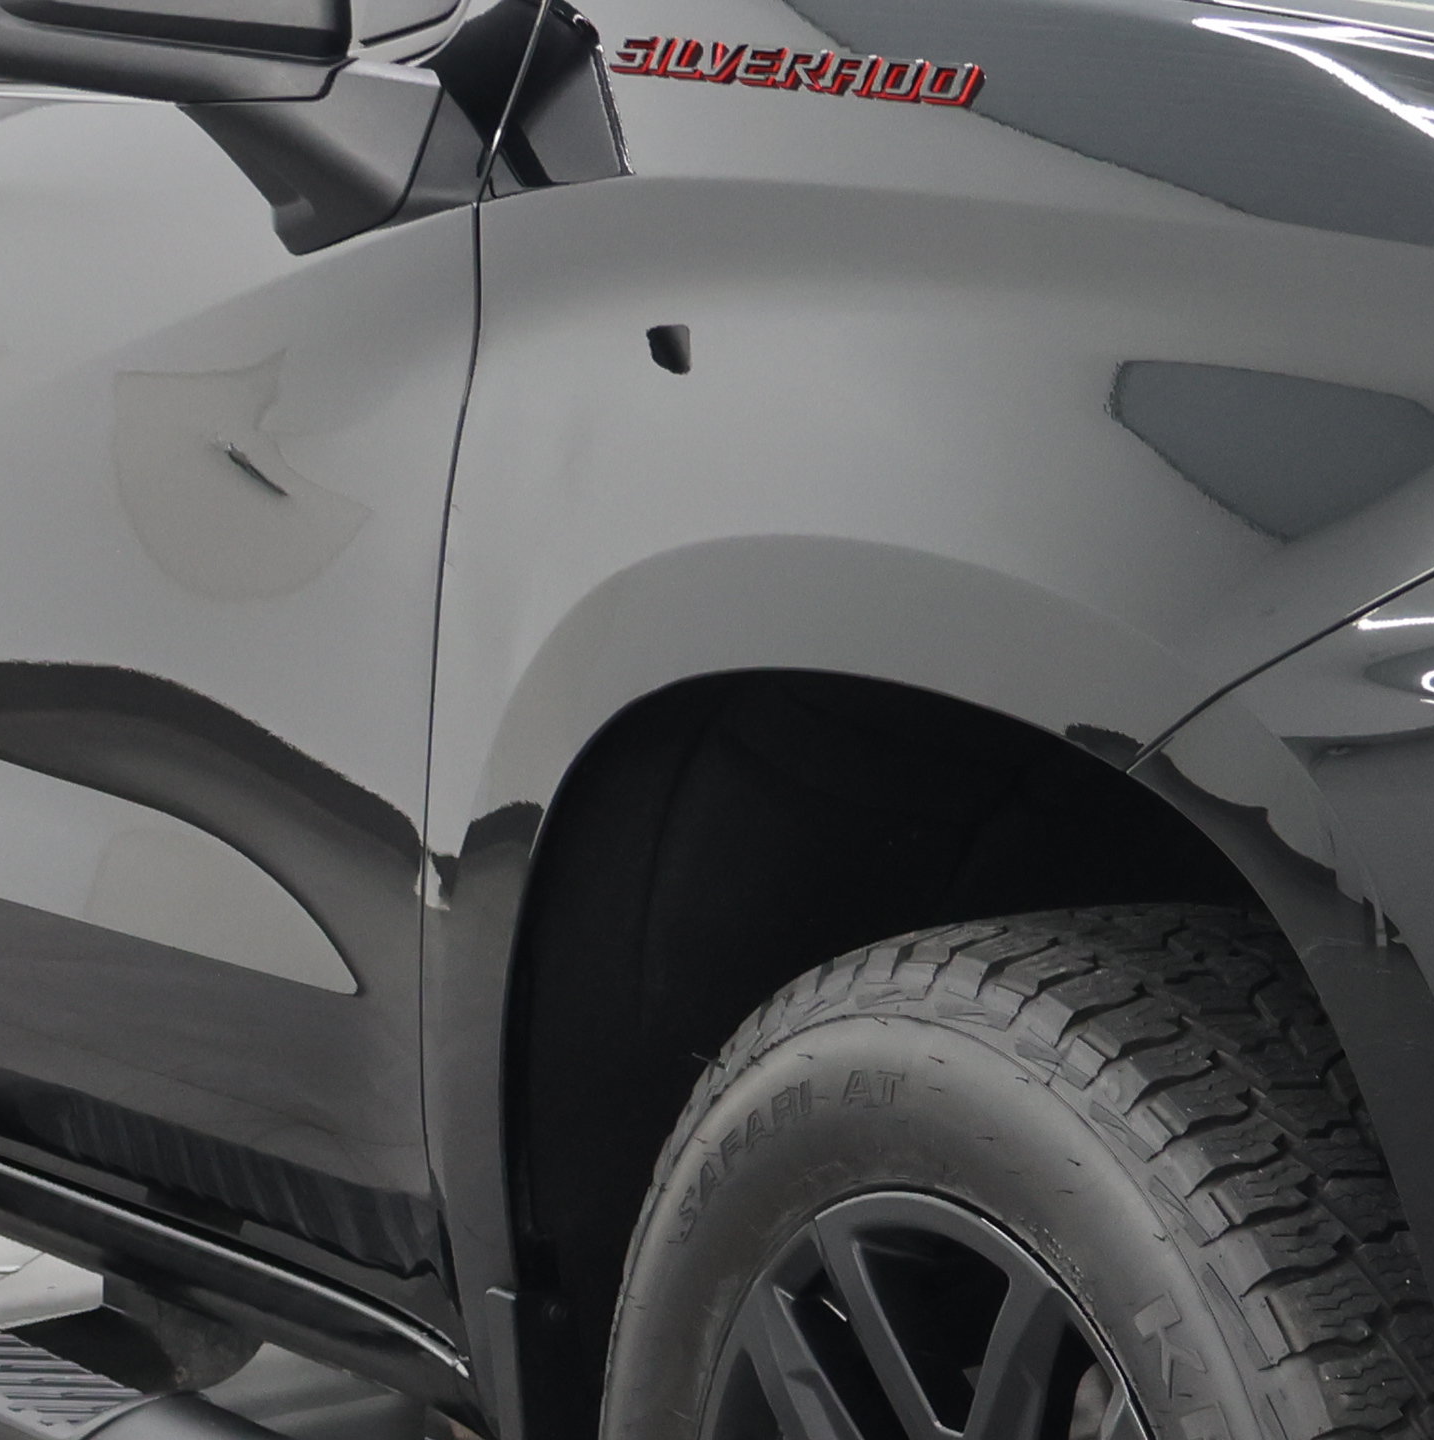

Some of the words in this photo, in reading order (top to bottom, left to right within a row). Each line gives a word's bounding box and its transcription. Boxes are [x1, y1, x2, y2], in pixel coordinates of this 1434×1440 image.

[609, 36, 986, 109] SILVERADO
[668, 1078, 814, 1244] SAFARI
[842, 1069, 906, 1107] AT
